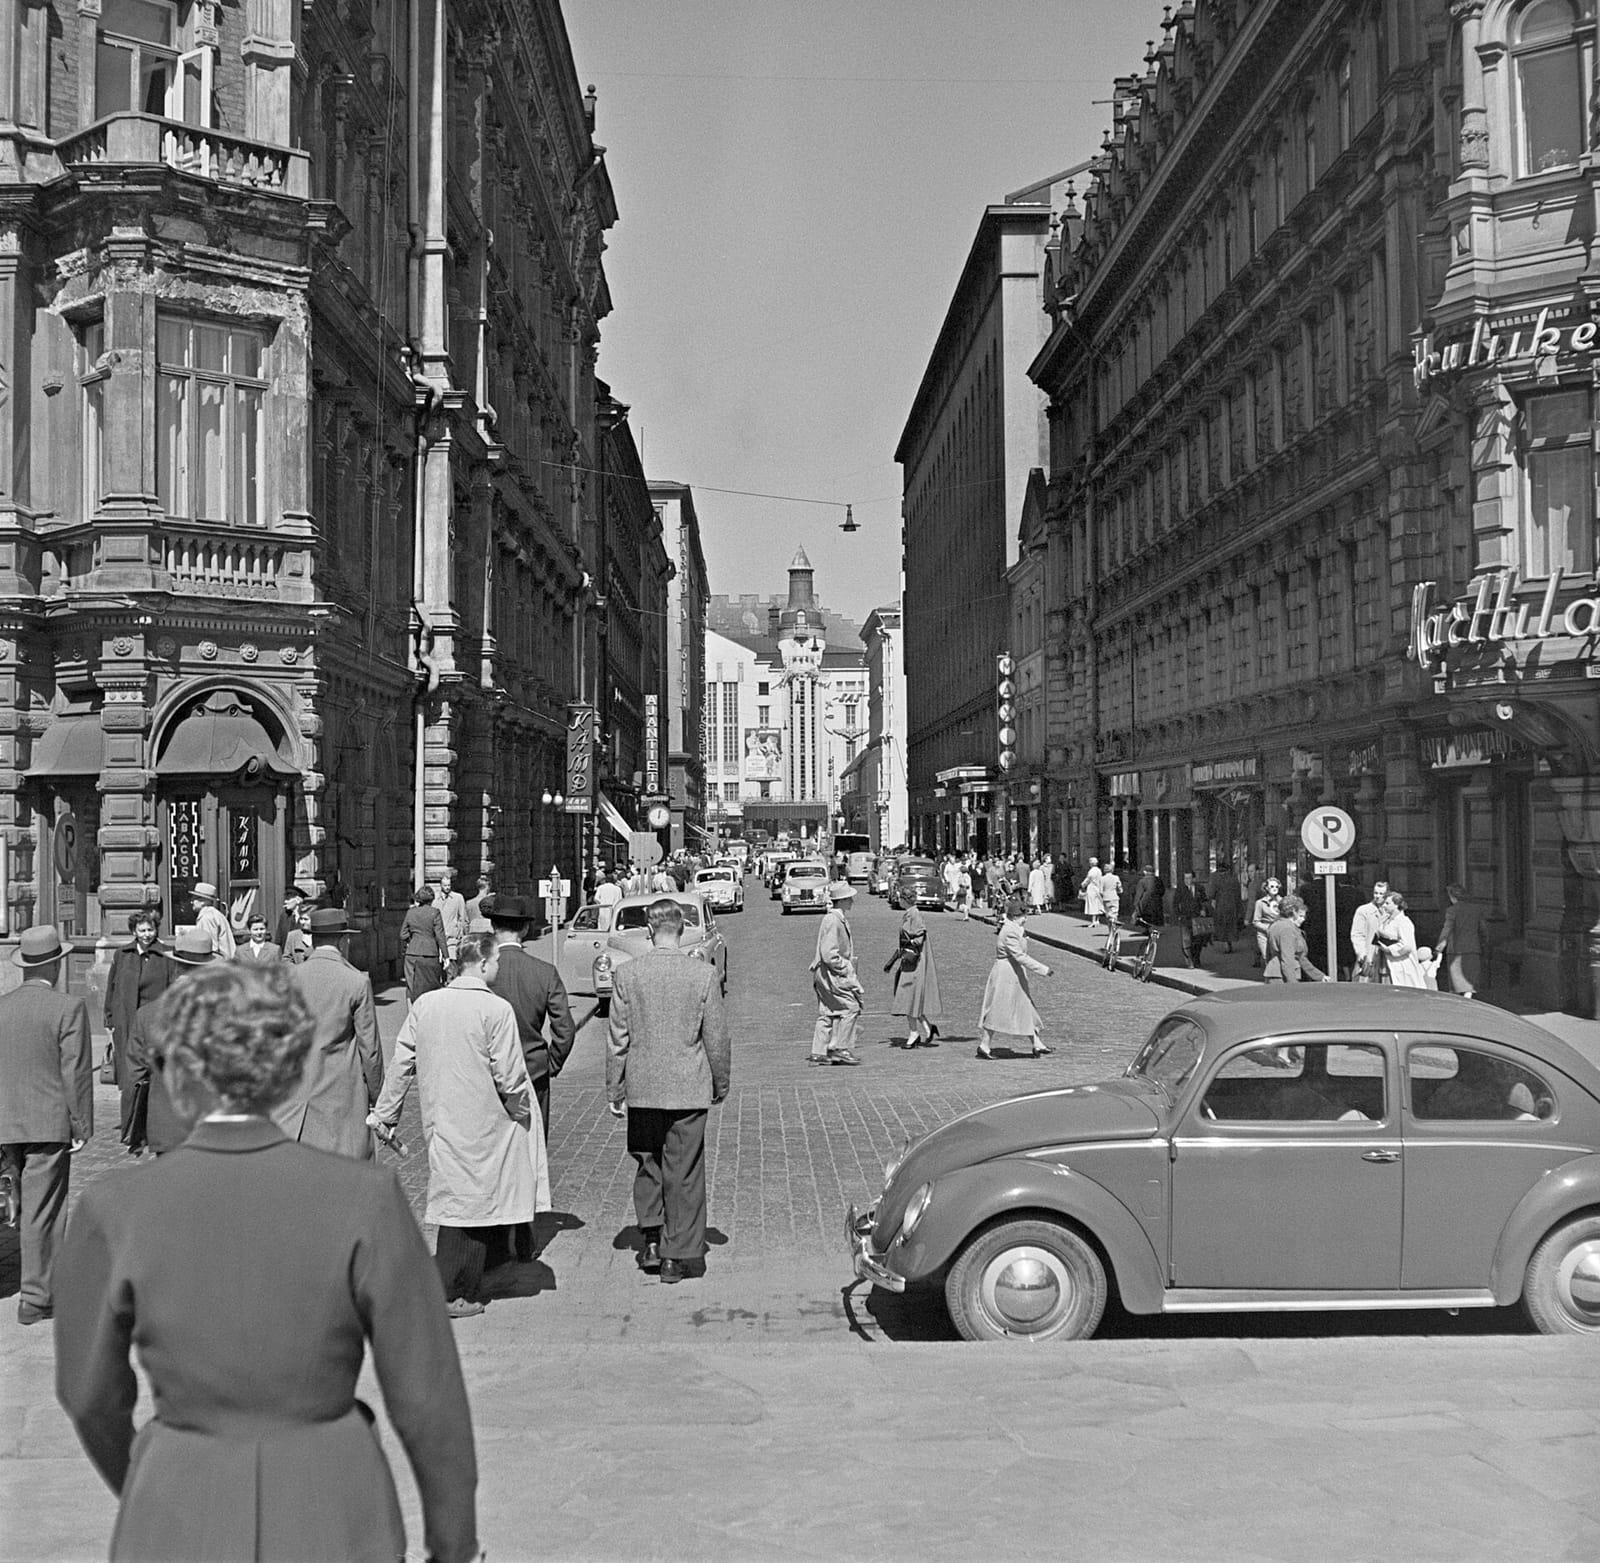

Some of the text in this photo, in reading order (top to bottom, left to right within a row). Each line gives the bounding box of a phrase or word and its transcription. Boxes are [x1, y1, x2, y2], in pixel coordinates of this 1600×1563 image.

[838, 692, 862, 703] SAS
[1000, 658, 1015, 769] MAXIM
[568, 711, 592, 794] KÄMP
[646, 696, 658, 792] AJANTIETO
[179, 802, 189, 877] TABACOS
